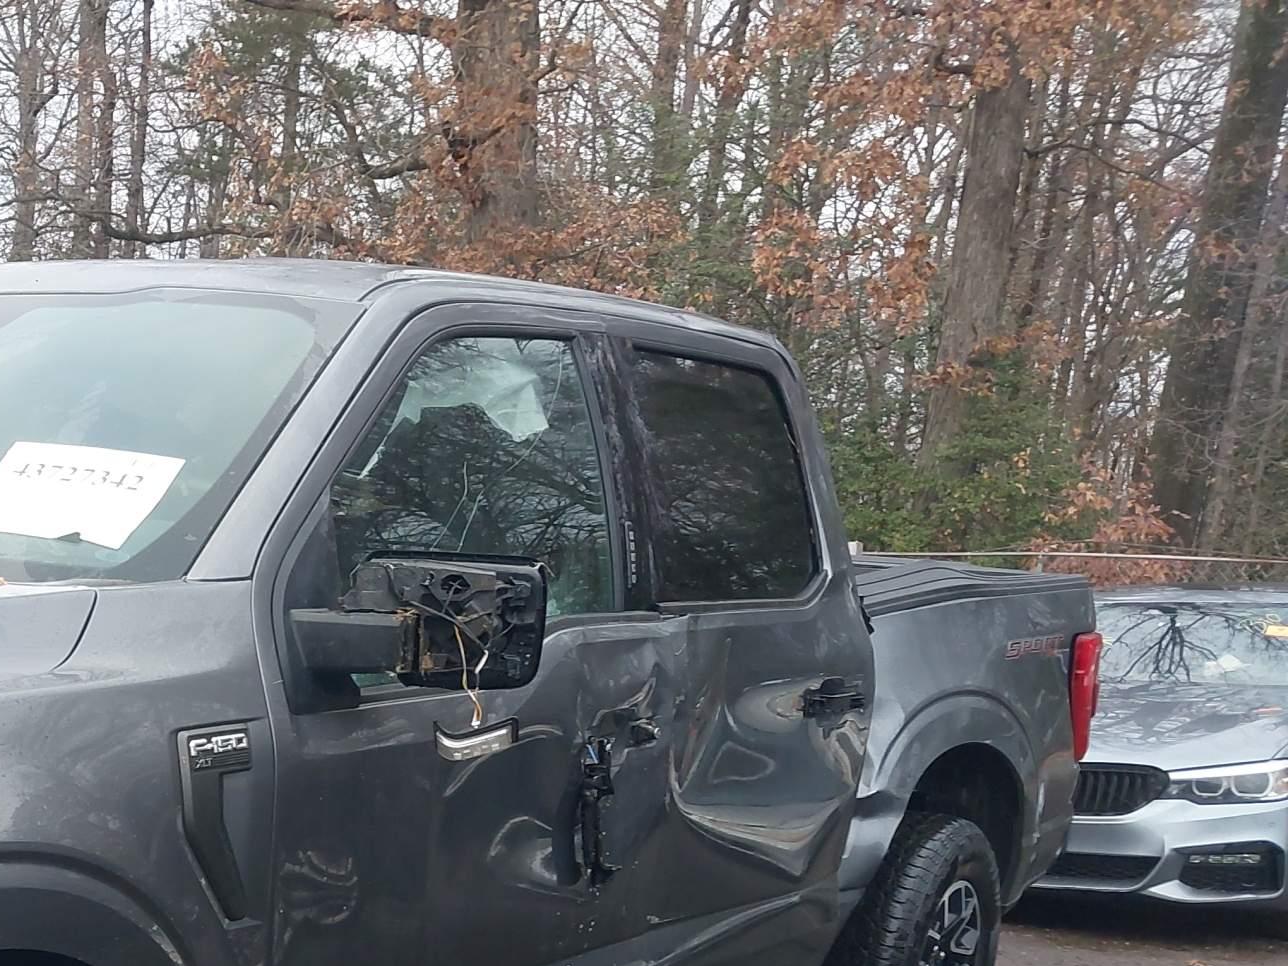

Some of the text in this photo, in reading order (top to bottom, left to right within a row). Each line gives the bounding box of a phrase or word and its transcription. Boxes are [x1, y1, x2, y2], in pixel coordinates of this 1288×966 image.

[12, 463, 144, 491] 43727342
[1004, 633, 1065, 661] SPORT
[189, 733, 248, 757] F-150
[194, 757, 213, 769] XLT
